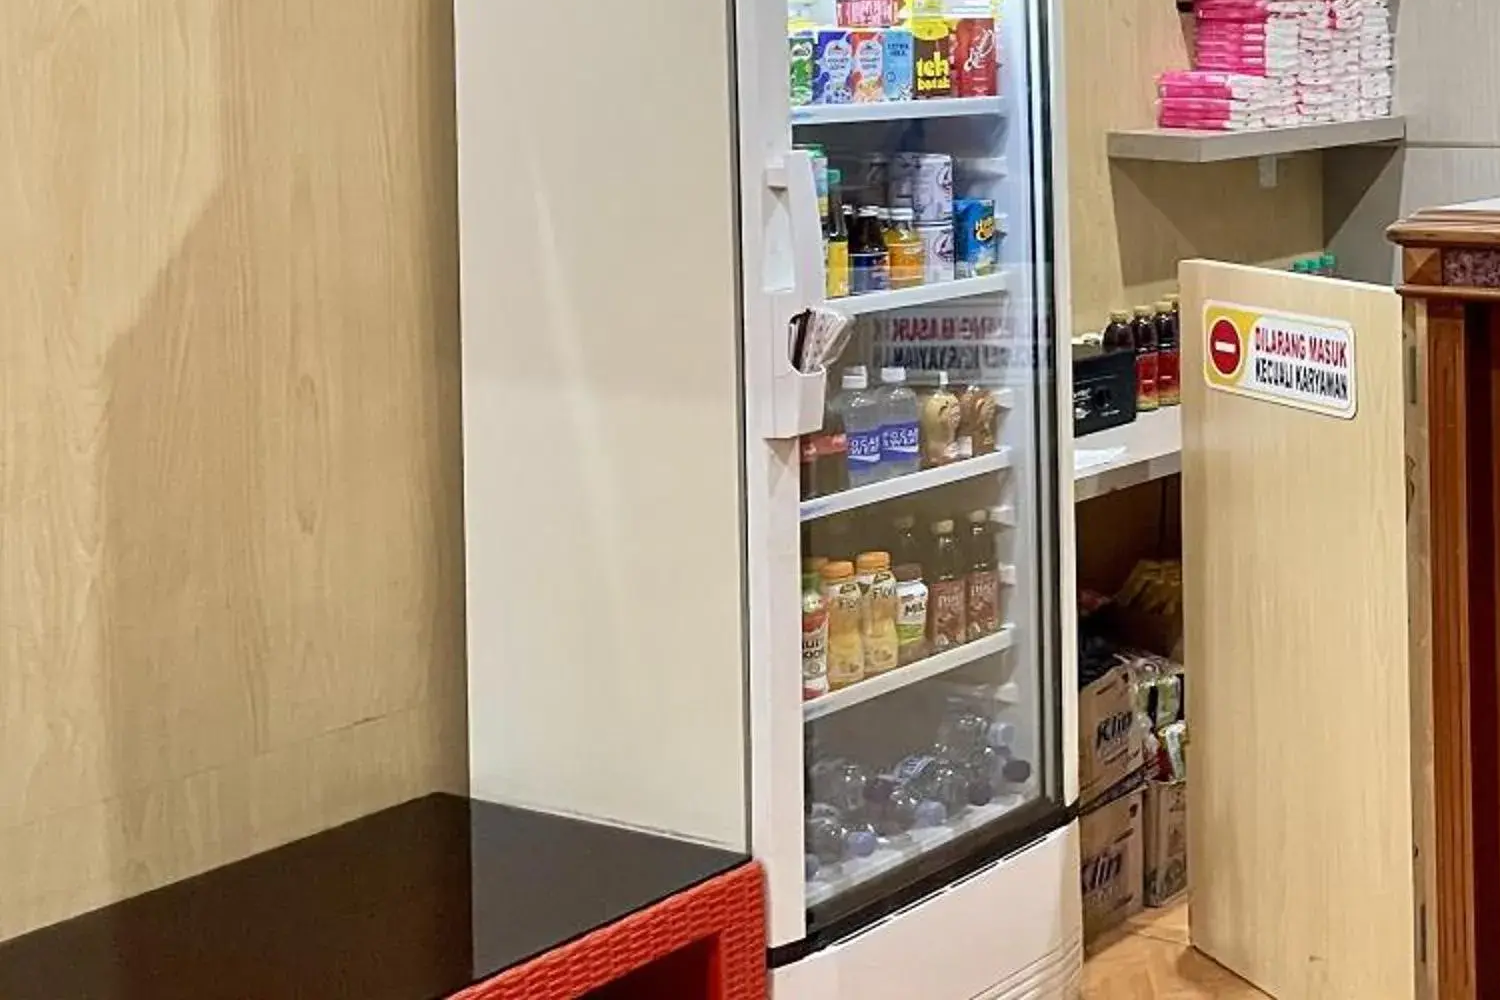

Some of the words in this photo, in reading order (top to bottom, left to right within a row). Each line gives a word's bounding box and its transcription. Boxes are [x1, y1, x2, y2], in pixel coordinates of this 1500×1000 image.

[1255, 327, 1306, 361] DILARANG
[1309, 335, 1348, 369] MASUK
[1255, 357, 1293, 389] KECUALI
